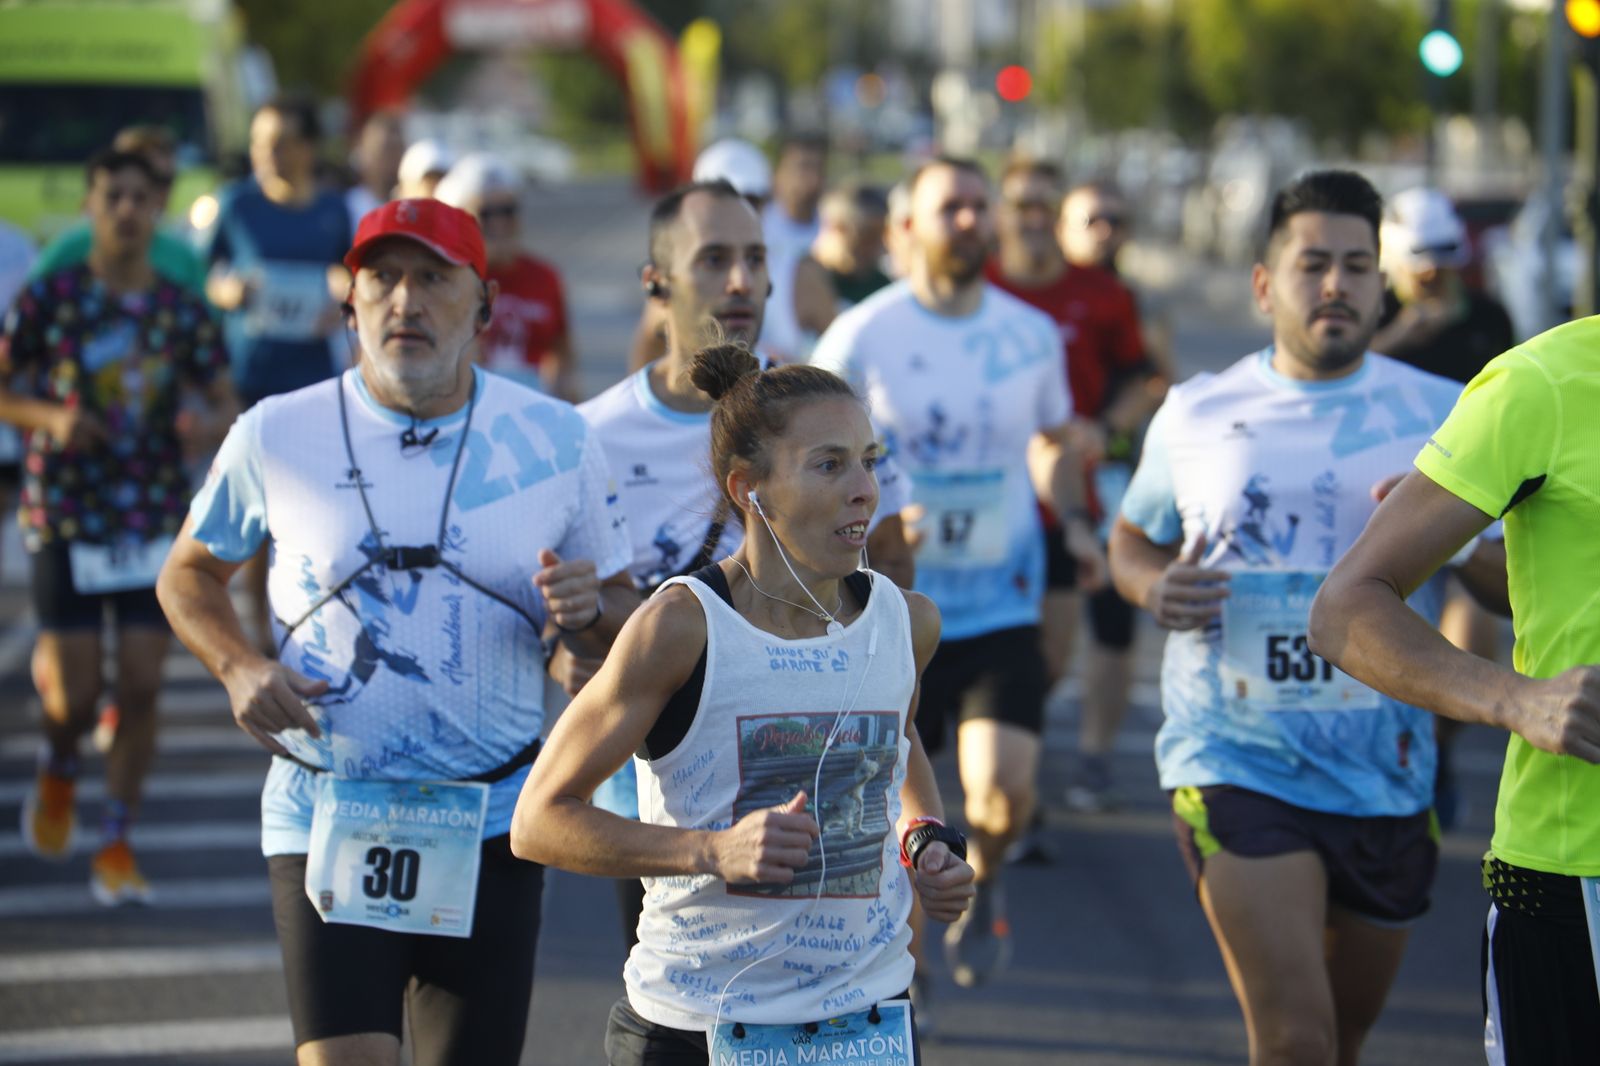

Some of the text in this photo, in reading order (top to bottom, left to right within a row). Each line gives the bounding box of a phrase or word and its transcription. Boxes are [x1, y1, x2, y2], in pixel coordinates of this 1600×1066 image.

[321, 801, 479, 828] MEDIA MARATÓN
[363, 846, 420, 902] 30
[719, 1031, 904, 1066] MEDIA MARATÓN
